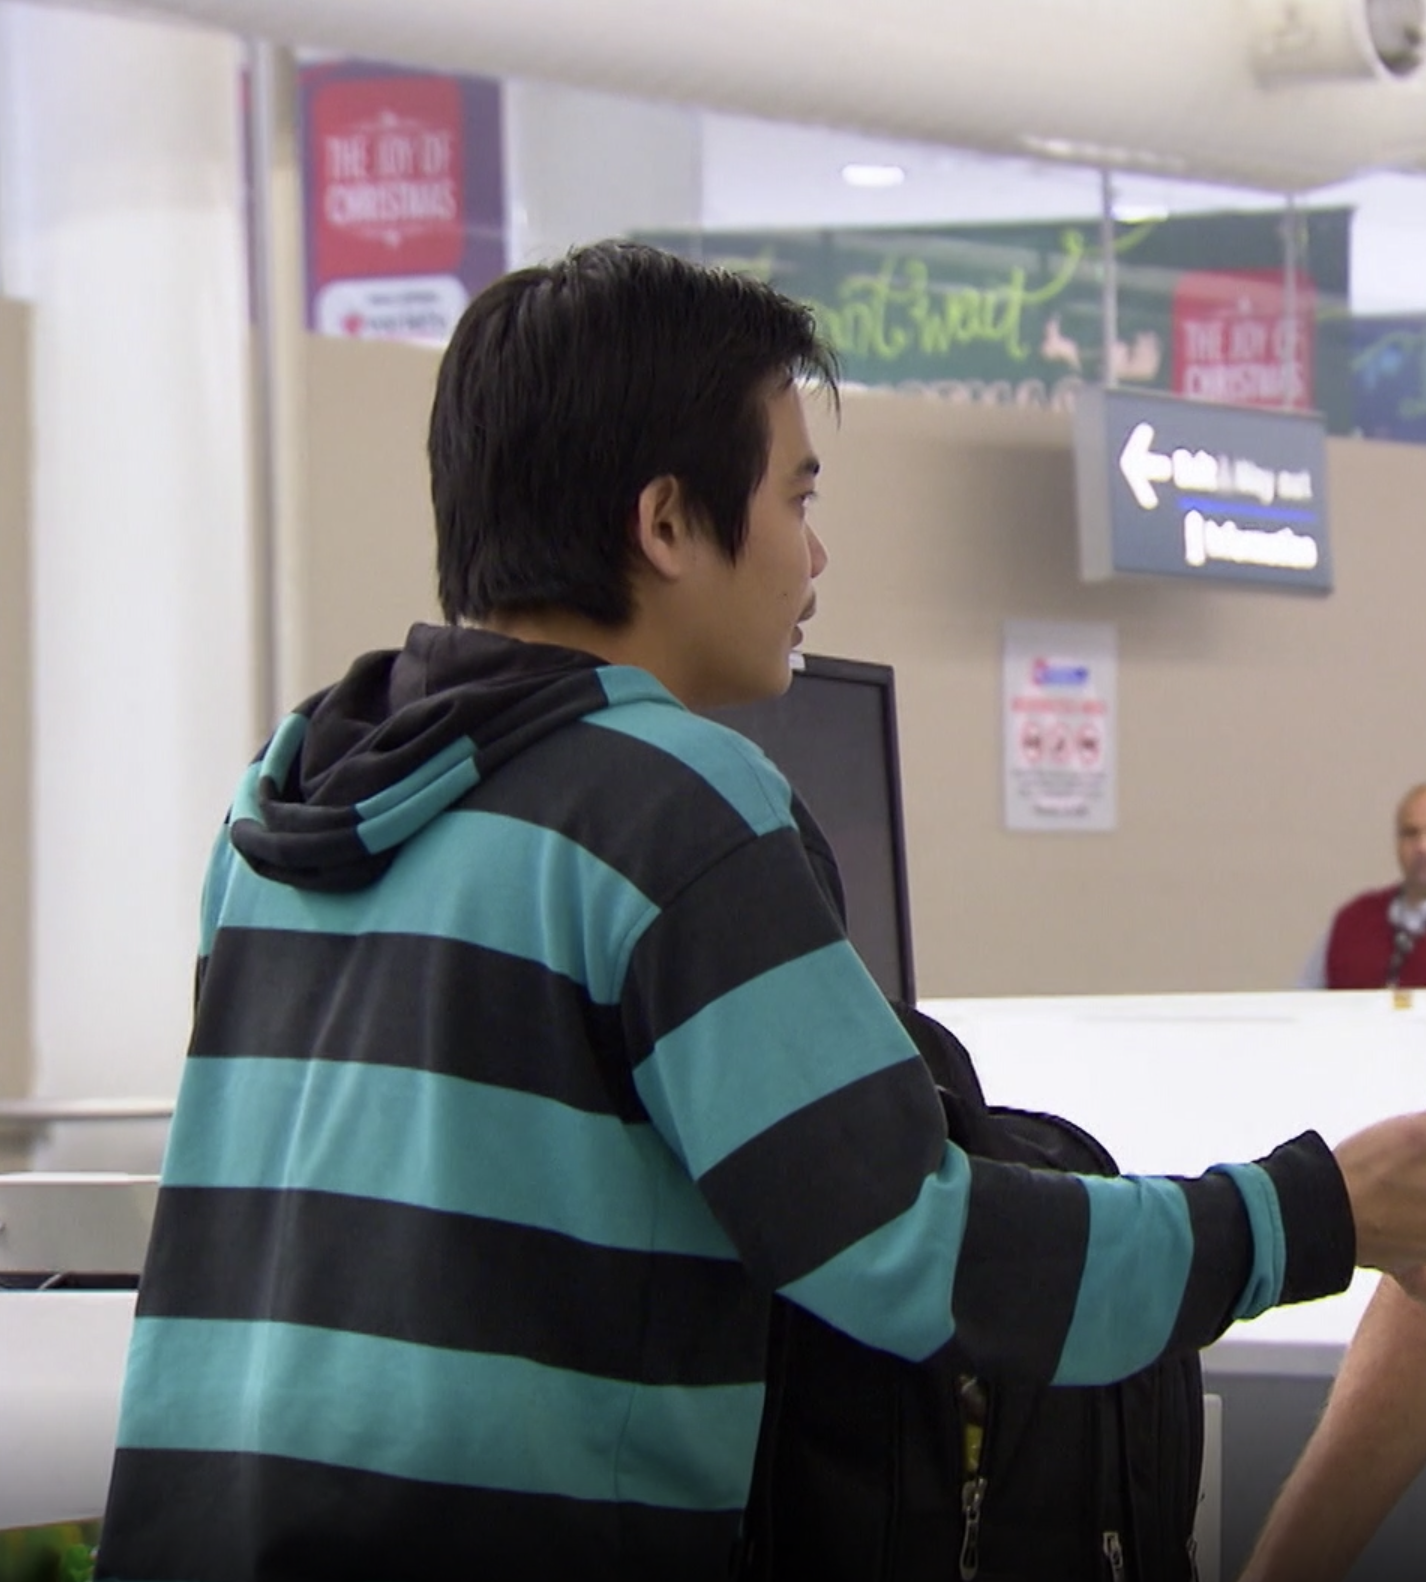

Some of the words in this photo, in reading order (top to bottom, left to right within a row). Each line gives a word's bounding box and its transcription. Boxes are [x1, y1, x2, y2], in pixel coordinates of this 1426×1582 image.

[325, 134, 368, 181] THE
[377, 132, 414, 177] JOY
[421, 128, 453, 177] OF
[325, 179, 457, 225] CHRISTMAS
[1182, 319, 1224, 361] THE
[1231, 320, 1267, 361] JOY
